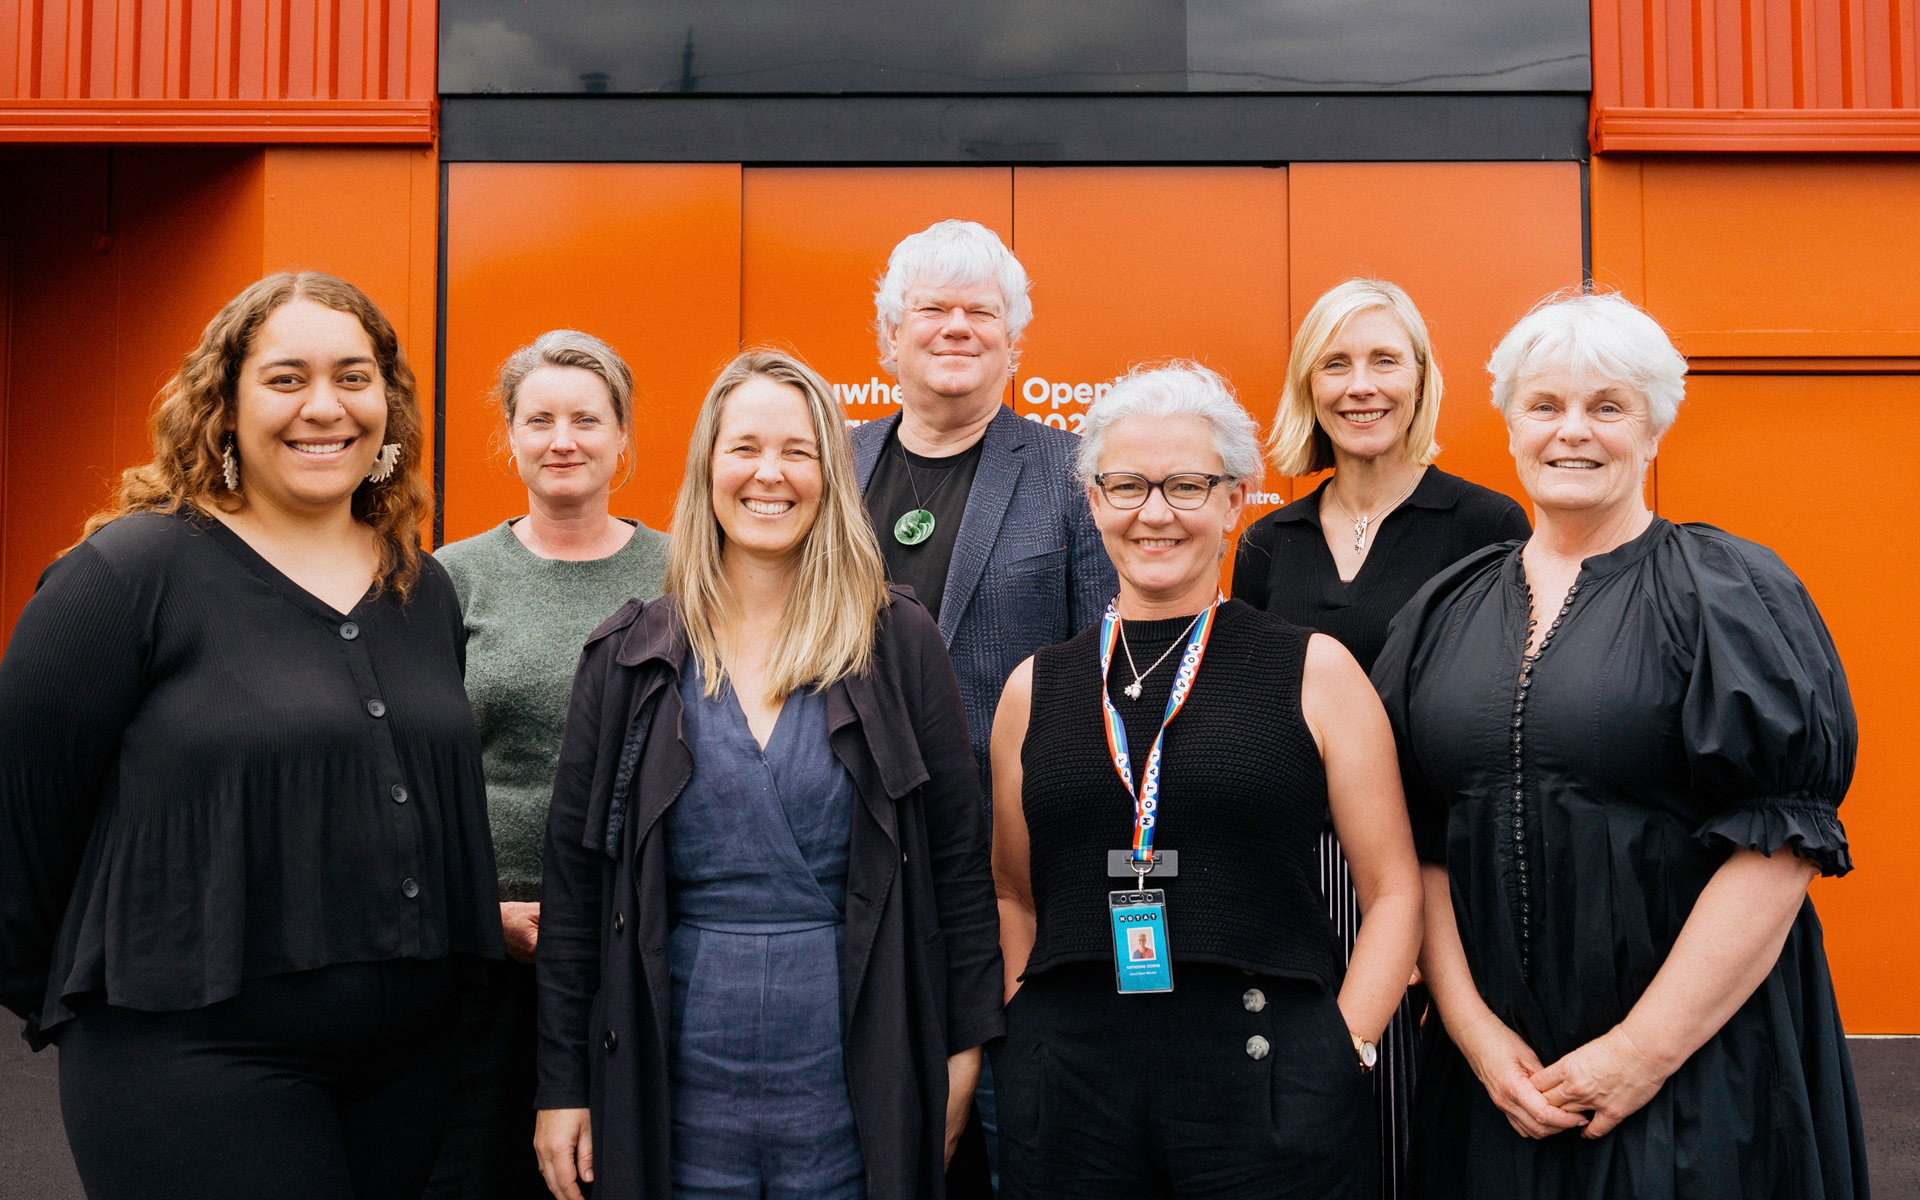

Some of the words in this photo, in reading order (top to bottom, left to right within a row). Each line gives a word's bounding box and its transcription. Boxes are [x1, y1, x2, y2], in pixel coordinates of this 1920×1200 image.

[1022, 376, 1123, 409] Open
[1173, 643, 1202, 704] MOTAT
[1140, 749, 1160, 829] MOTAT
